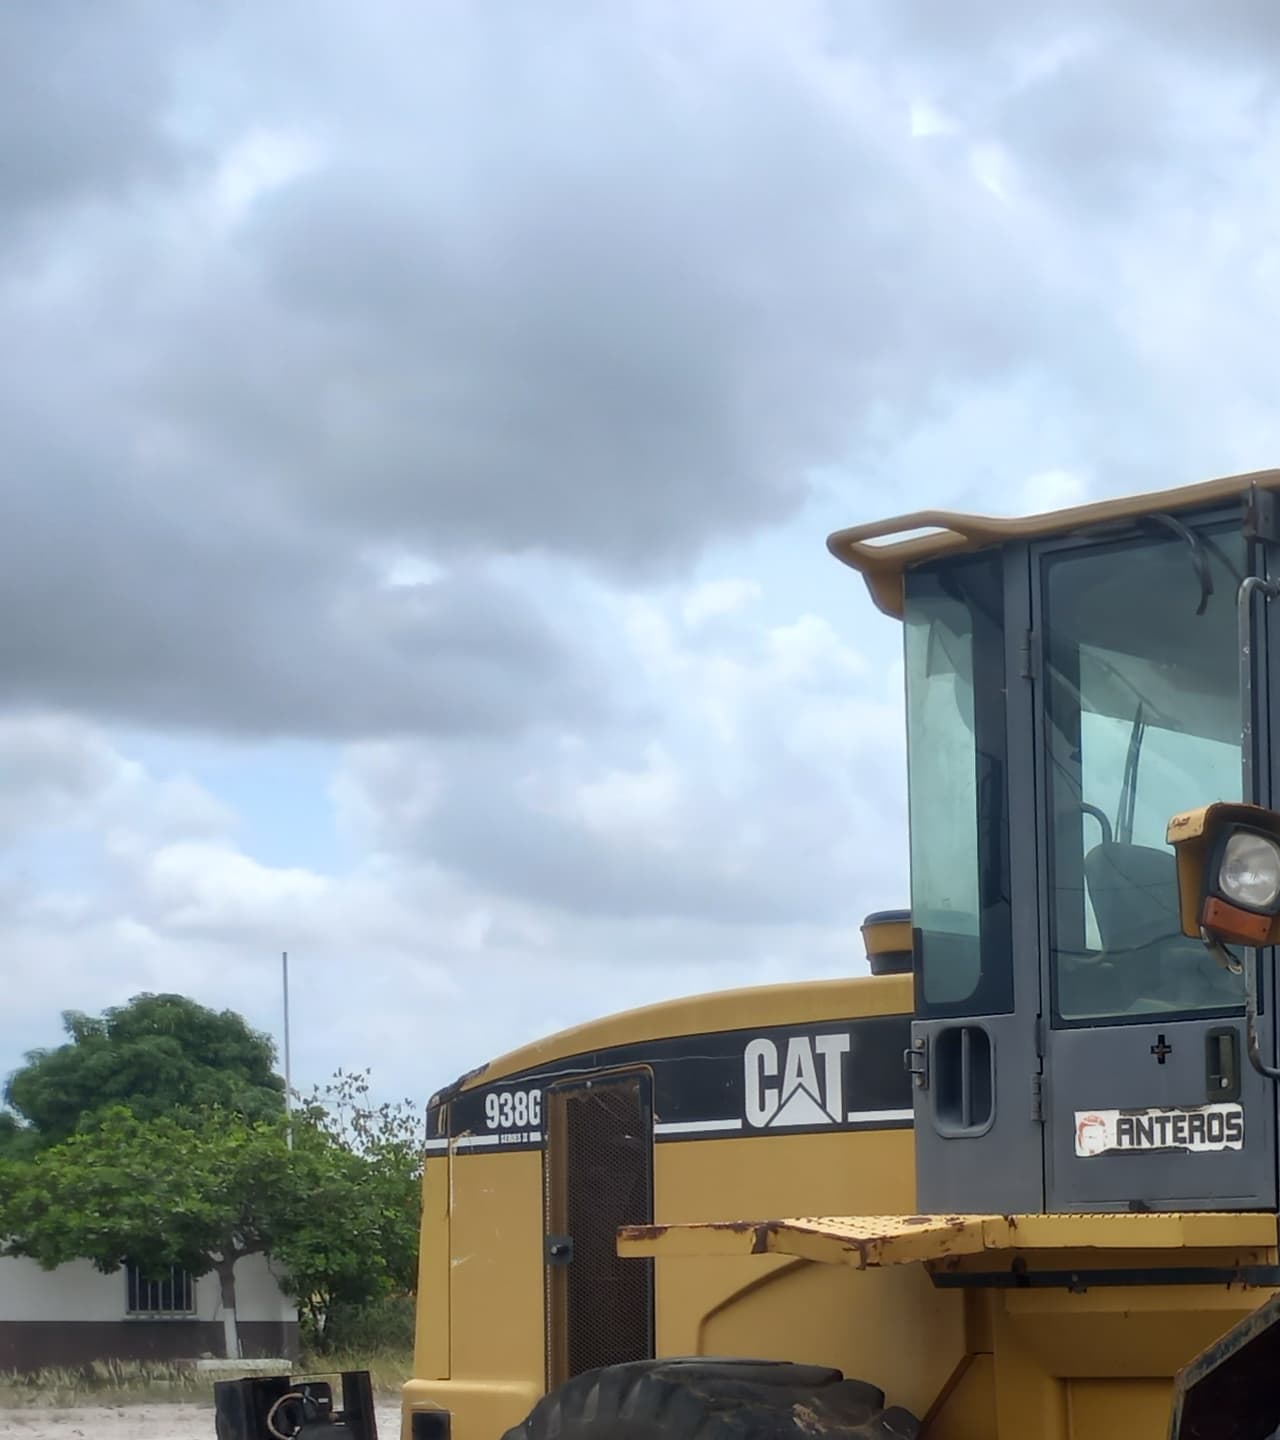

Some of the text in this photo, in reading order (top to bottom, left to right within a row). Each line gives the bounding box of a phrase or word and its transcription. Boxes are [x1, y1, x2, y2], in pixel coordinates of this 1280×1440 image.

[744, 1033, 850, 1128] CAT
[485, 1089, 541, 1129] 938G
[1116, 1111, 1242, 1147] ANTEROS
